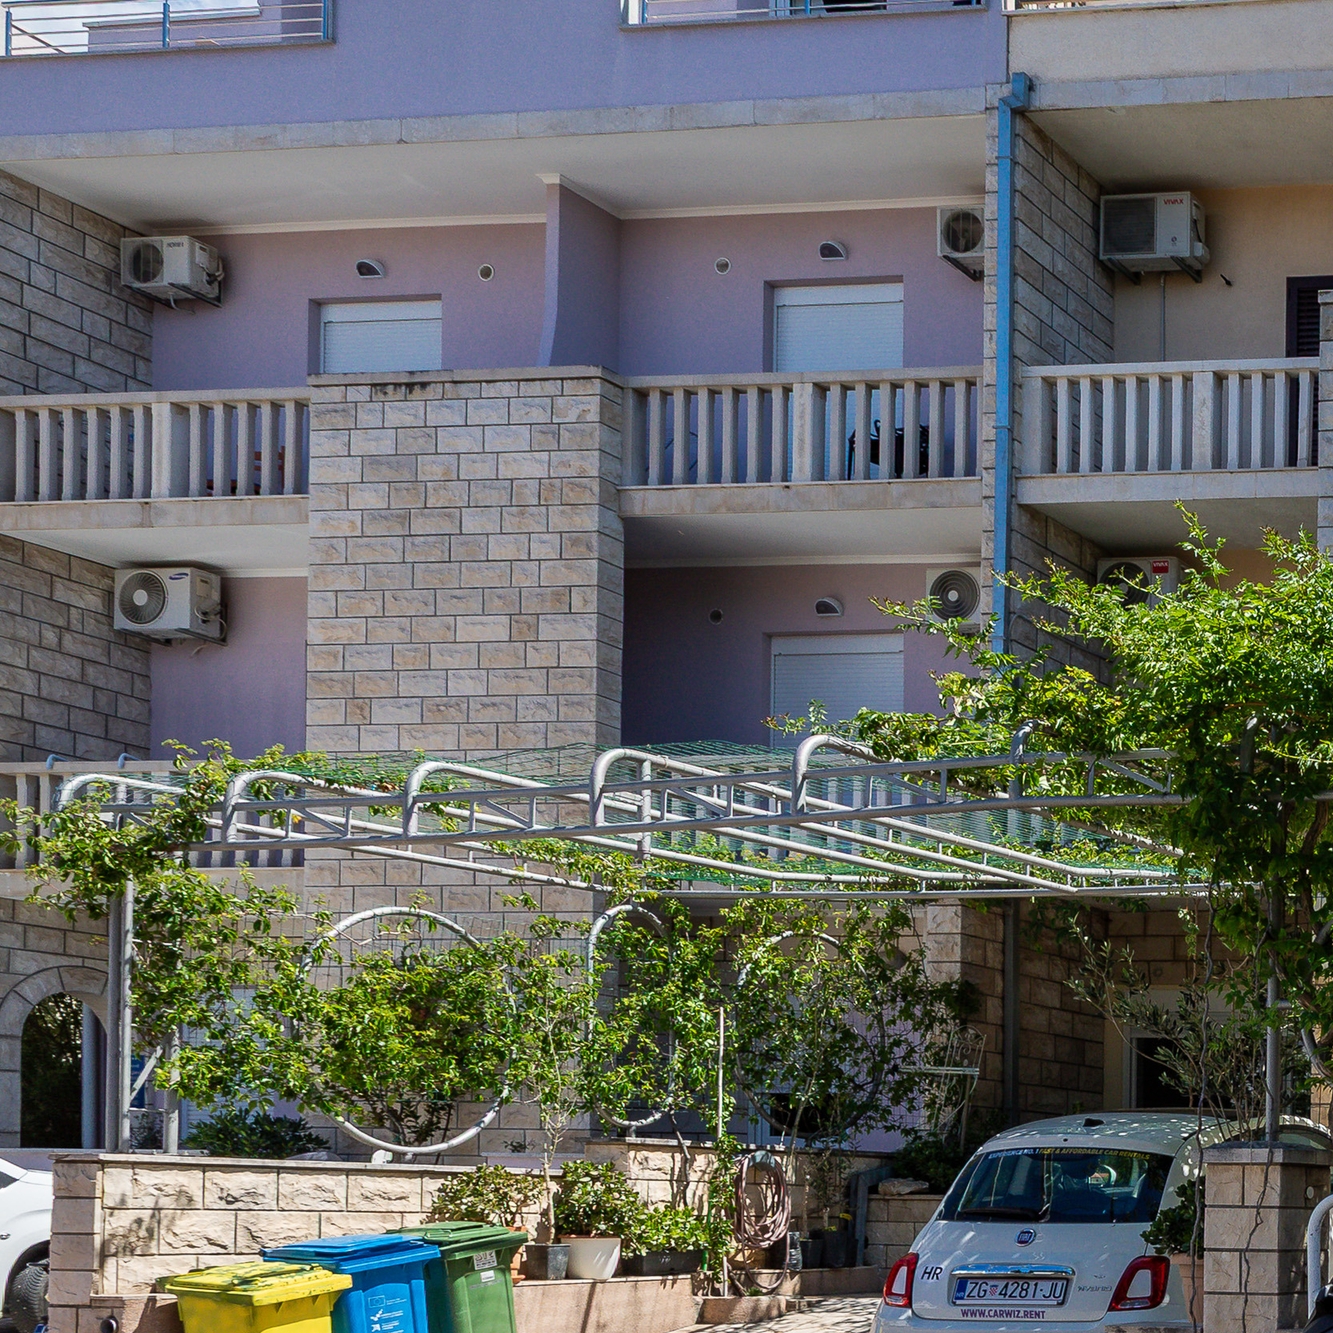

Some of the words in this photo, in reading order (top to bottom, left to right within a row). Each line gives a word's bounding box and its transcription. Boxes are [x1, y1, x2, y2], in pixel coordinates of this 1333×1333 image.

[1118, 1151, 1151, 1160] RENTALS
[920, 1266, 943, 1281] HR
[966, 1282, 989, 1299] ZG
[960, 1308, 1046, 1319] WWW.CARWIZ.RENT
